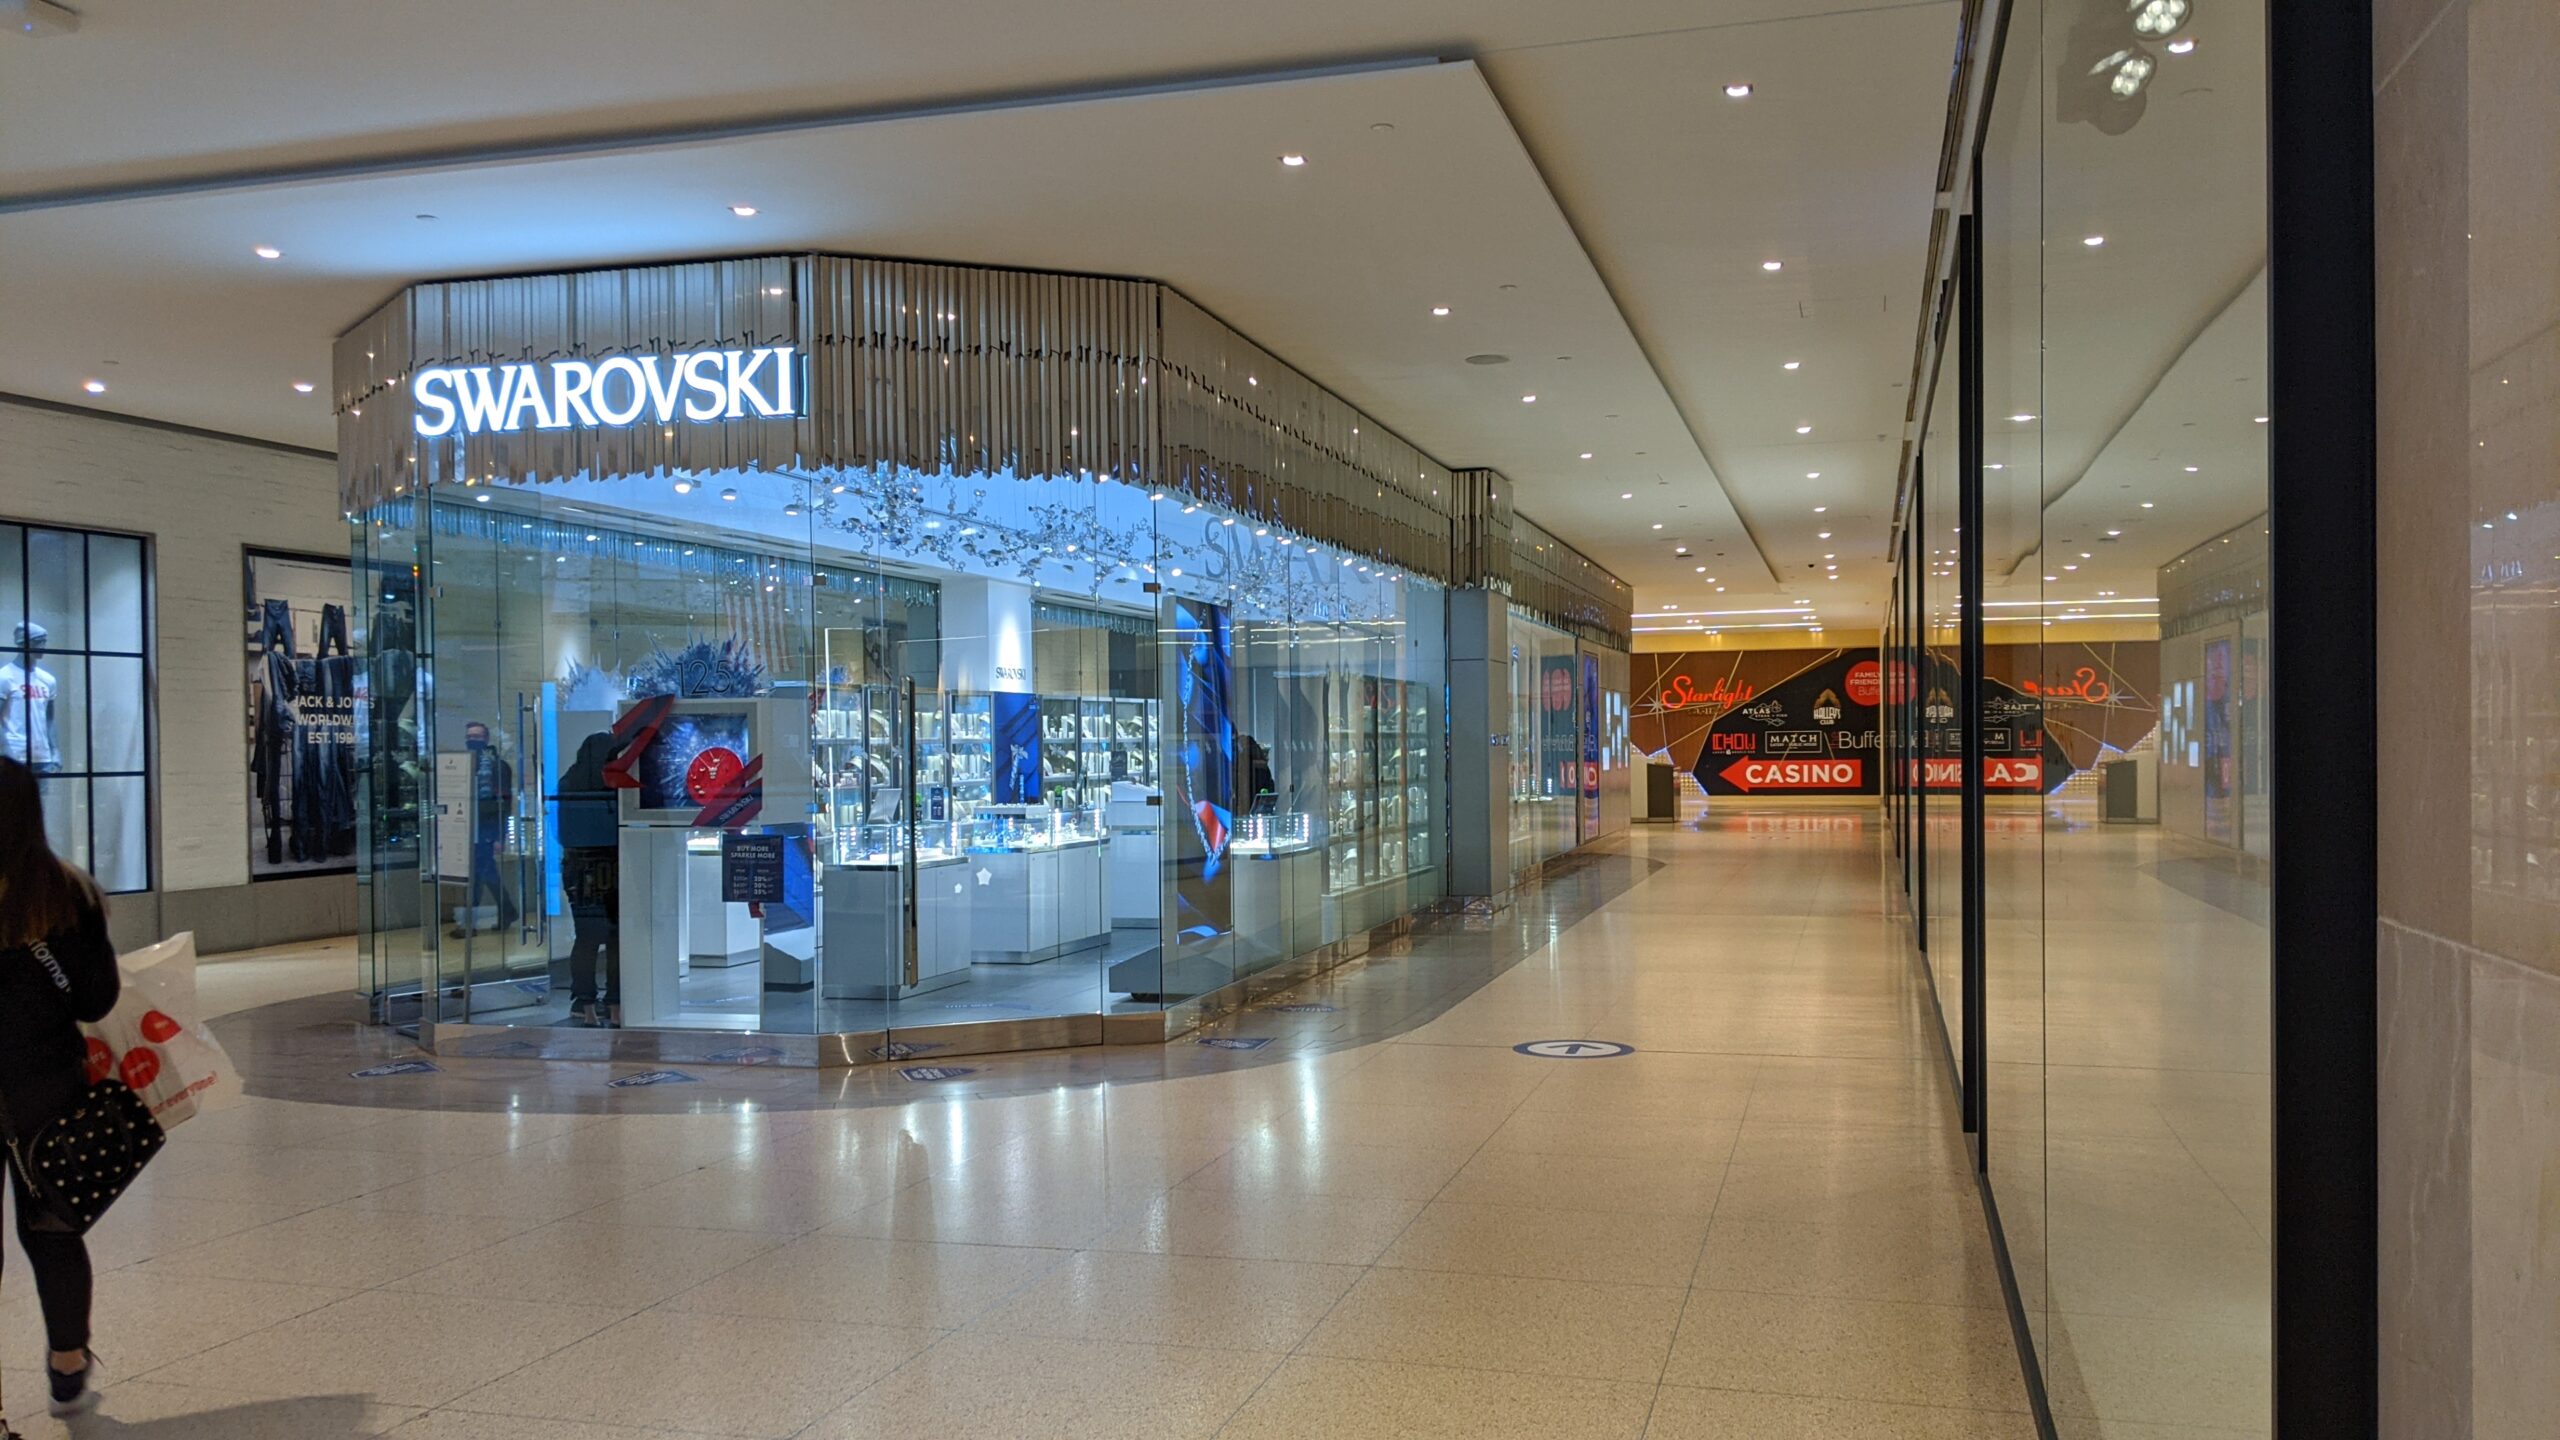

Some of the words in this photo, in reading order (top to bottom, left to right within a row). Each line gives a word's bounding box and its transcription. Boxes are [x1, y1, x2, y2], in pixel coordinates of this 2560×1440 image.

[413, 345, 798, 440] SWAROVSKI
[674, 660, 731, 697] 125
[1662, 675, 1753, 709] Starlight
[307, 732, 331, 744] EST.
[1770, 734, 1817, 743] MATCH
[1838, 731, 1881, 749] Buffe
[1745, 764, 1853, 784] CASINO
